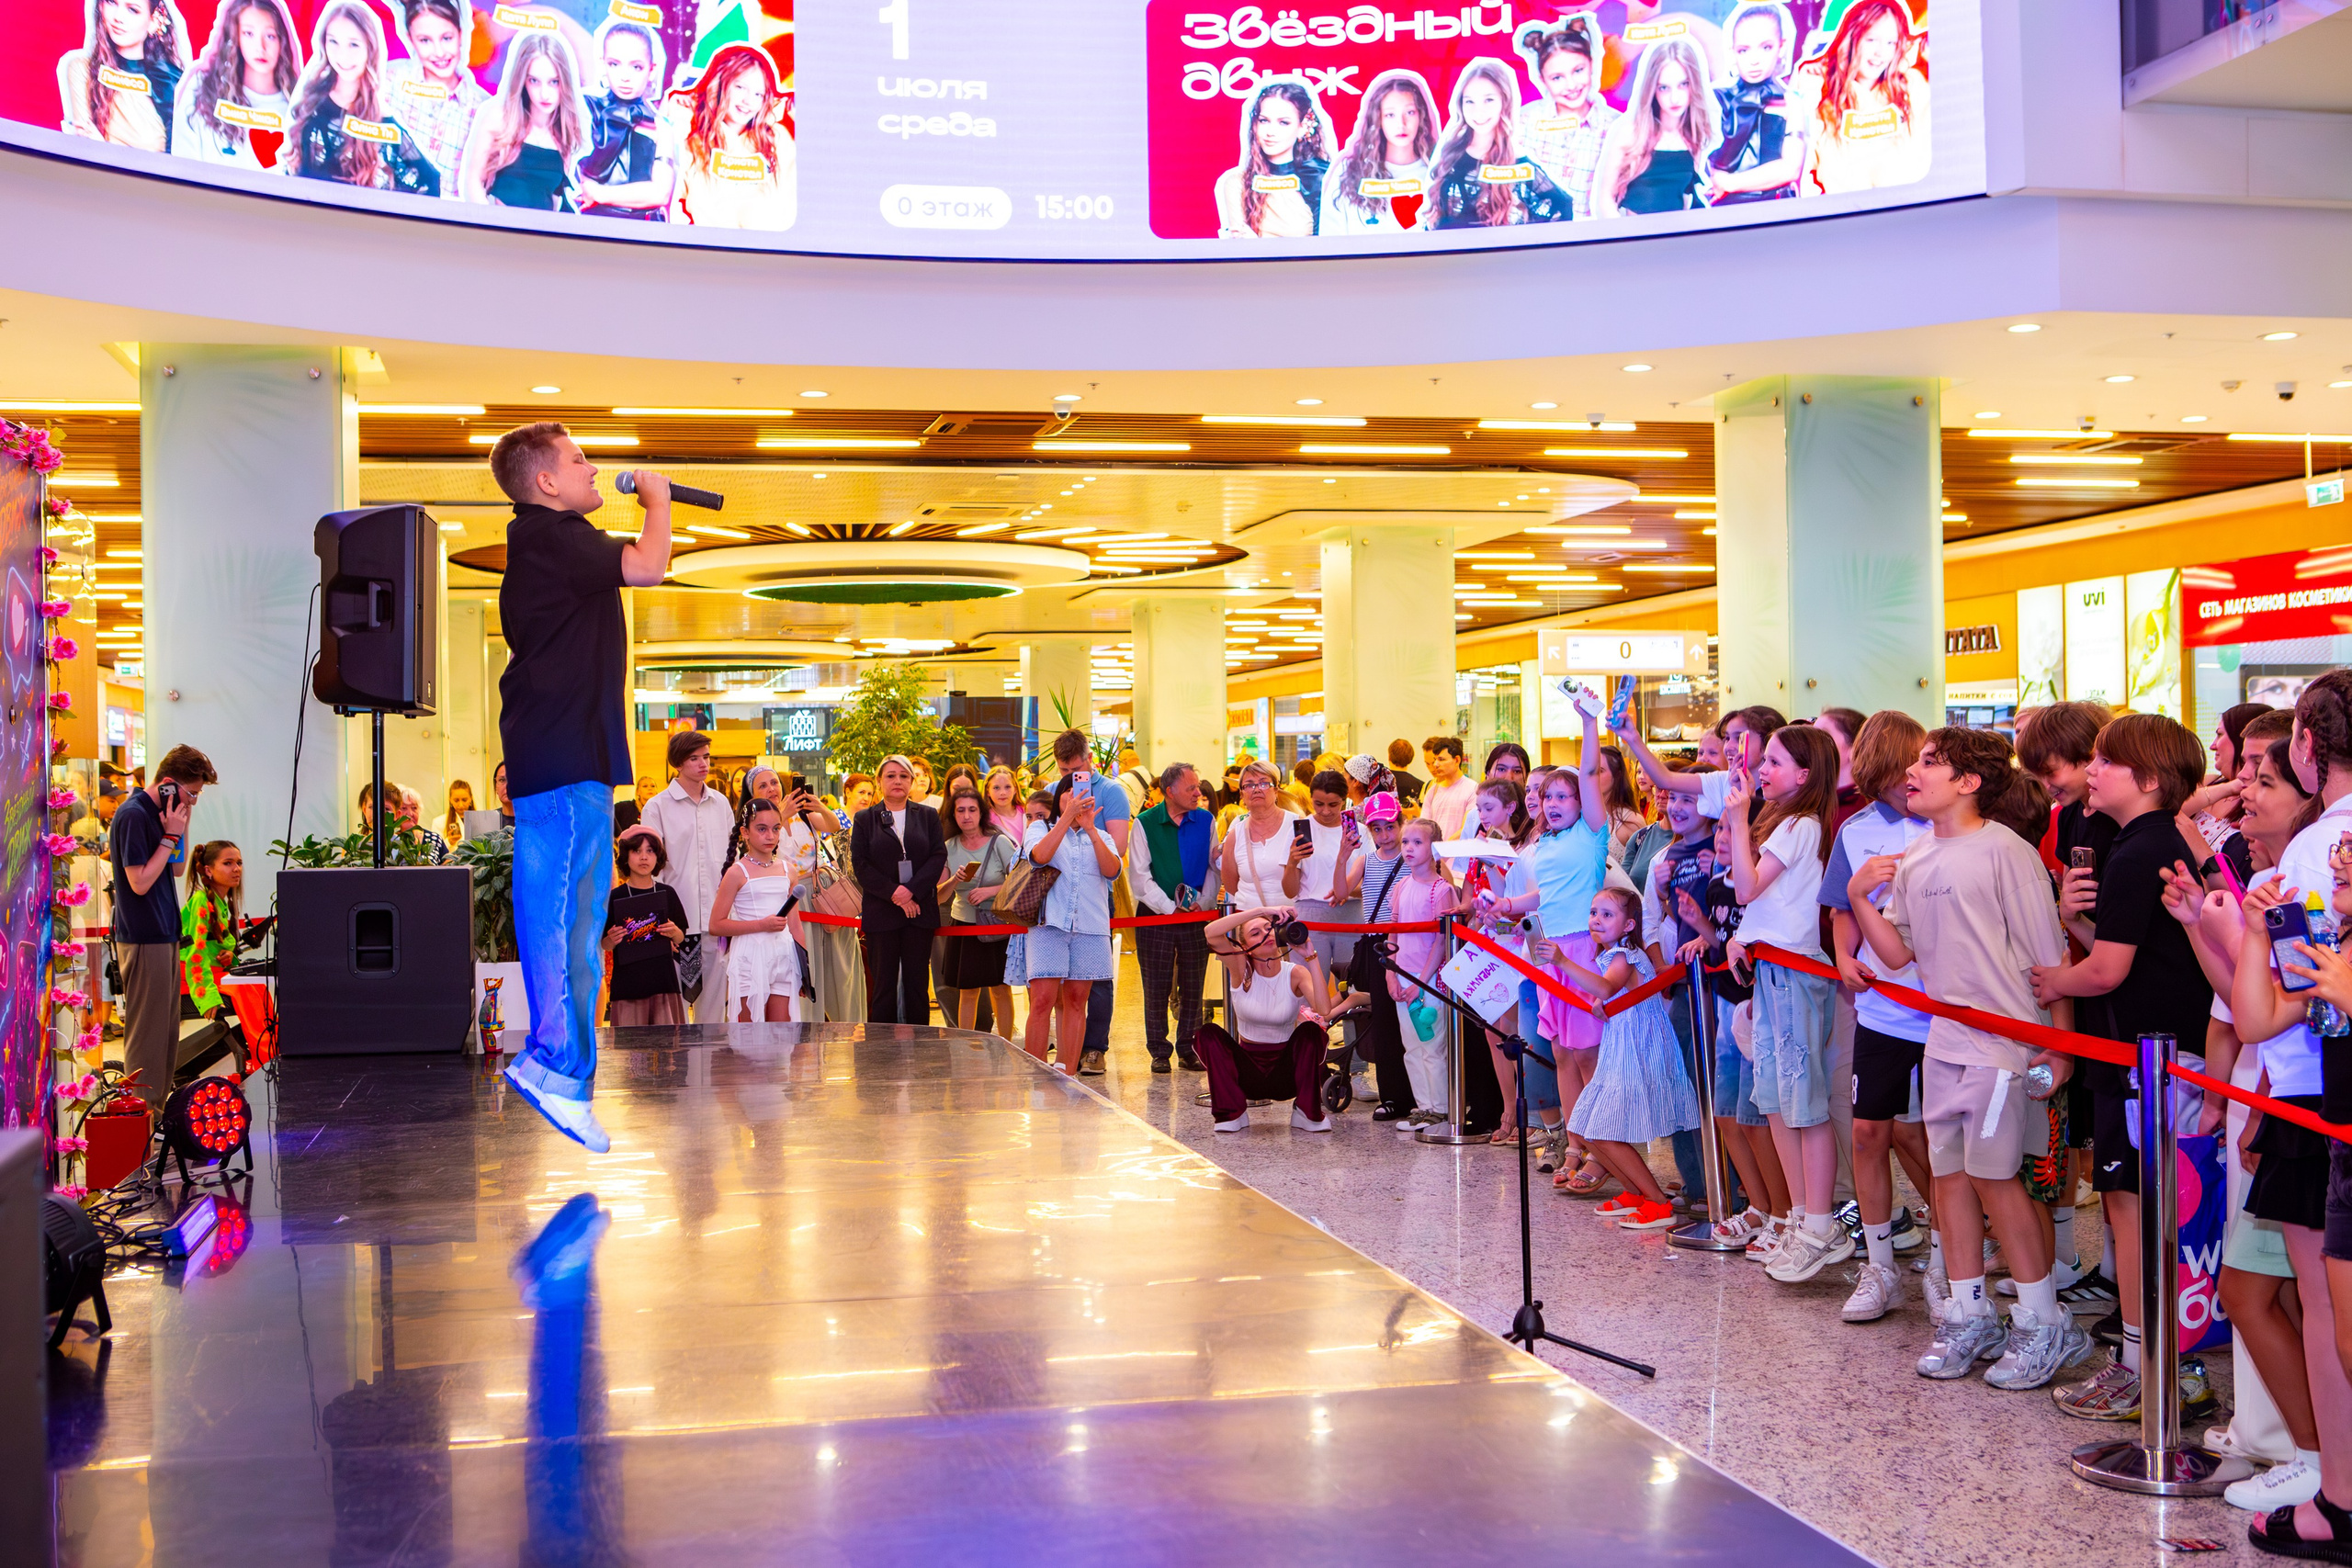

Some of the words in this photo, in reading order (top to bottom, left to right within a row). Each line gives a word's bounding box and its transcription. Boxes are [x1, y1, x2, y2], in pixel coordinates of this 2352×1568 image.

[879, 0, 910, 60] 1
[877, 76, 988, 100] июля
[1182, 57, 1363, 100] двж
[877, 111, 997, 140] среда
[922, 199, 994, 218] этаж
[1035, 194, 1114, 220] 15:00
[2199, 600, 2222, 618] СЕТЬ
[2223, 592, 2287, 615] МАГАЗИНОВ
[1620, 641, 1632, 660] 0
[1973, 1284, 1982, 1301] FILA
